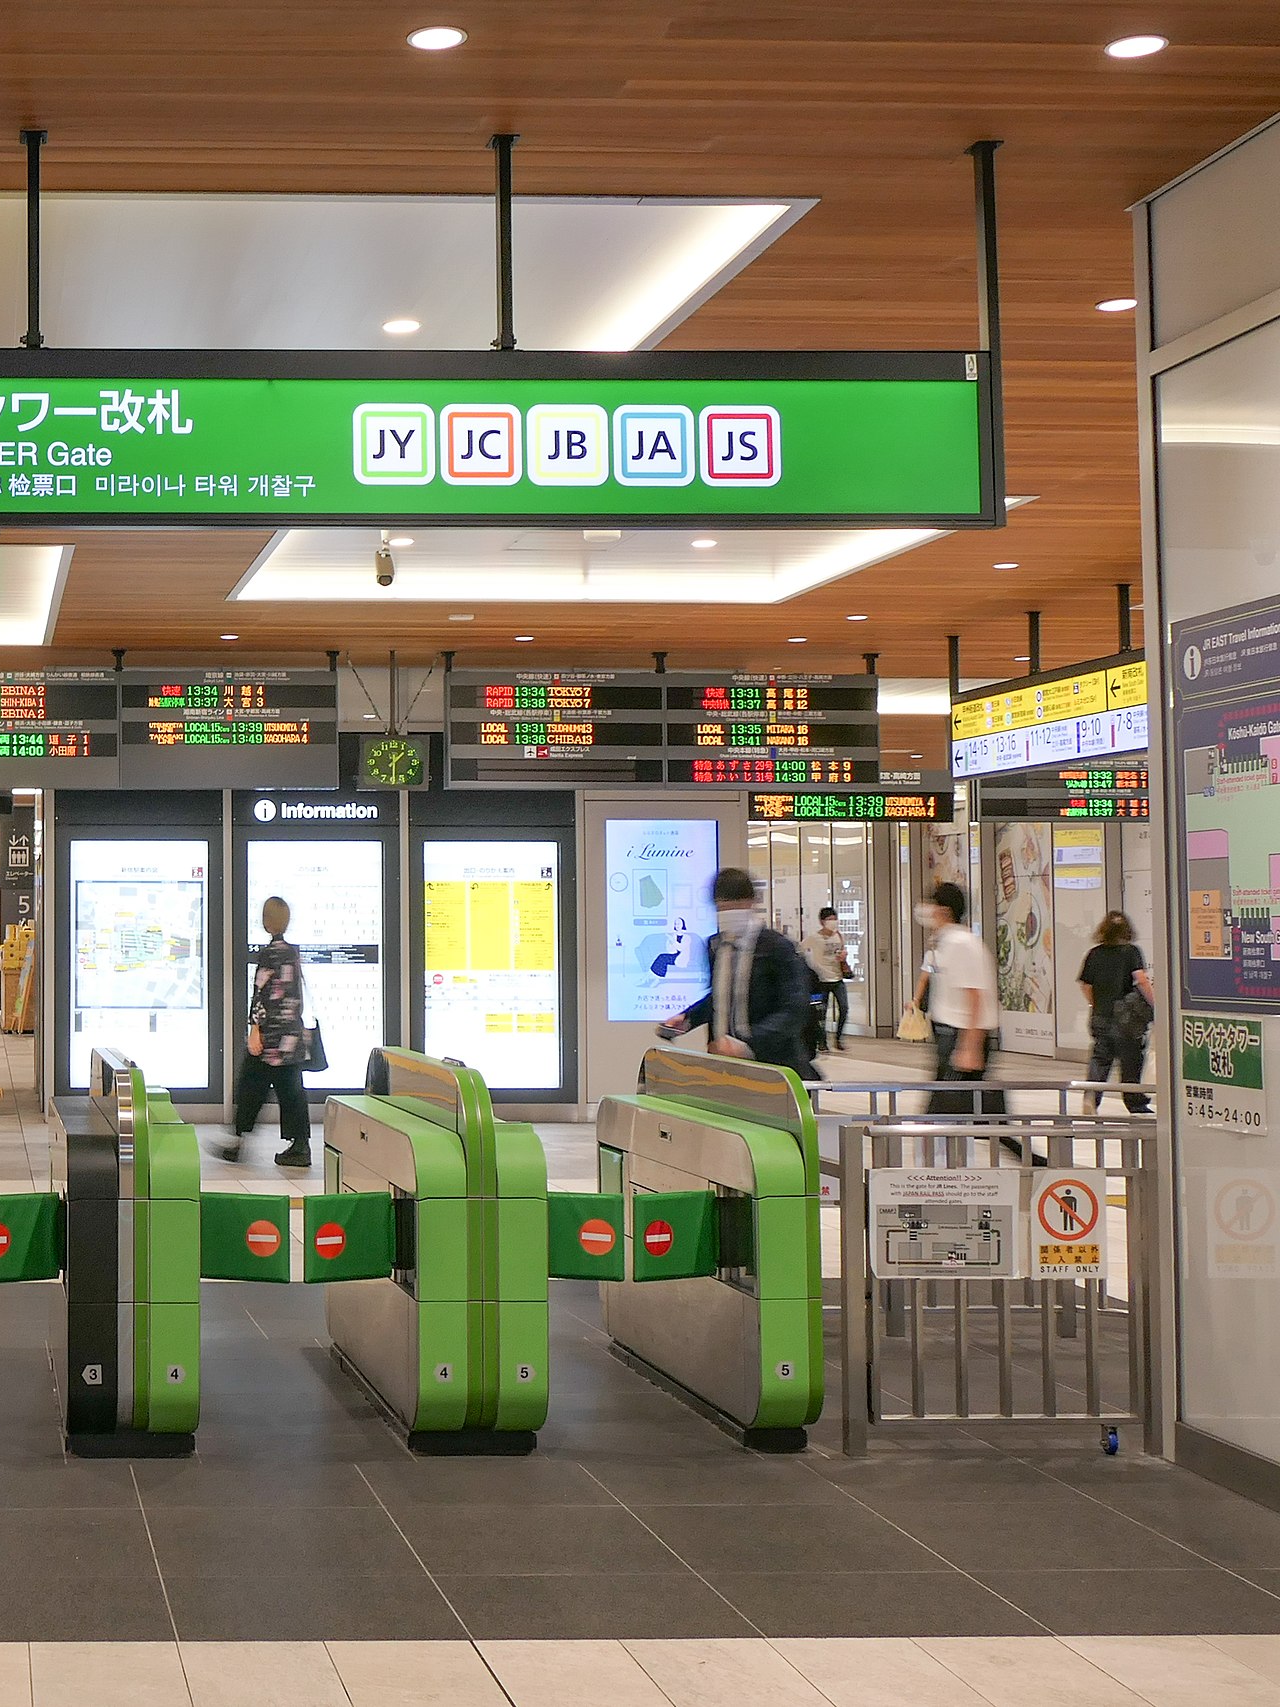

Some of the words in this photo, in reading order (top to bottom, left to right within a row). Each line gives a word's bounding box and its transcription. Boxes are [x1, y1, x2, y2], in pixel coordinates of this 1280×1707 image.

[373, 429, 415, 462] JY
[461, 429, 502, 462] JC
[548, 429, 588, 462] JB
[631, 429, 677, 462] JA
[721, 429, 758, 462] JS
[47, 442, 113, 466] Gate
[8, 474, 77, 497] 检票口
[95, 474, 186, 497] 미라이나
[195, 474, 239, 497] 타워
[247, 474, 316, 497] 개찰구
[1211, 634, 1228, 649] EAST
[1228, 629, 1247, 646] Travel
[0, 686, 36, 697] EBINA
[37, 686, 45, 697] 2
[161, 685, 182, 697] 快速
[186, 685, 218, 697] 13:34
[486, 686, 513, 697] RAPID
[514, 686, 545, 697] 13:34
[730, 688, 760, 698] 13:31
[796, 688, 808, 698] 12
[186, 697, 218, 708] 13:37
[486, 698, 513, 709] RAPID
[514, 698, 546, 709] 13:38
[730, 699, 761, 710] 13:37
[796, 699, 808, 710] 12
[0, 708, 36, 719] EBINA
[37, 708, 45, 719] 2
[184, 722, 211, 733] LOCAL
[232, 722, 263, 733] 13:39
[480, 723, 508, 733] LOCAL
[515, 723, 545, 733] 13:31
[697, 724, 724, 734] LOCAL
[731, 724, 761, 734] 13:35
[12, 734, 44, 745] 13:44
[184, 734, 211, 744] LOCAL
[232, 734, 263, 744] 13:49
[480, 734, 508, 745] LOCAL
[515, 734, 546, 745] 13:36
[546, 734, 582, 745] CHIBA
[697, 736, 724, 746] LOCAL
[731, 736, 761, 746] 13:41
[12, 745, 44, 757] 14:00
[694, 760, 713, 771] 特急
[775, 760, 806, 771] 14:00
[842, 760, 851, 771] 9
[694, 772, 713, 783] 特急
[775, 772, 806, 783] 14:30
[842, 772, 851, 783] 9
[1088, 771, 1113, 780] 13:32
[794, 796, 824, 806] LOCAL
[848, 796, 883, 806] 13:39
[281, 802, 379, 819] Information
[794, 806, 824, 817] LOCAL
[848, 806, 883, 817] 13:49
[1088, 808, 1113, 817] 13:37
[635, 843, 694, 860] Lumine
[18, 896, 30, 914] 5
[1241, 931, 1254, 944] New
[1184, 1021, 1260, 1051] ミライナタワー
[1210, 1051, 1234, 1077] 改札
[1185, 1085, 1214, 1100] 営業時間
[1040, 1245, 1099, 1254] 関係者以外
[1040, 1265, 1069, 1273] STAFF
[1075, 1265, 1100, 1273] ONLY
[89, 1369, 98, 1380] 3
[170, 1368, 179, 1380] 4
[439, 1367, 448, 1379] 4
[520, 1367, 529, 1379] 5
[781, 1363, 790, 1376] 5
